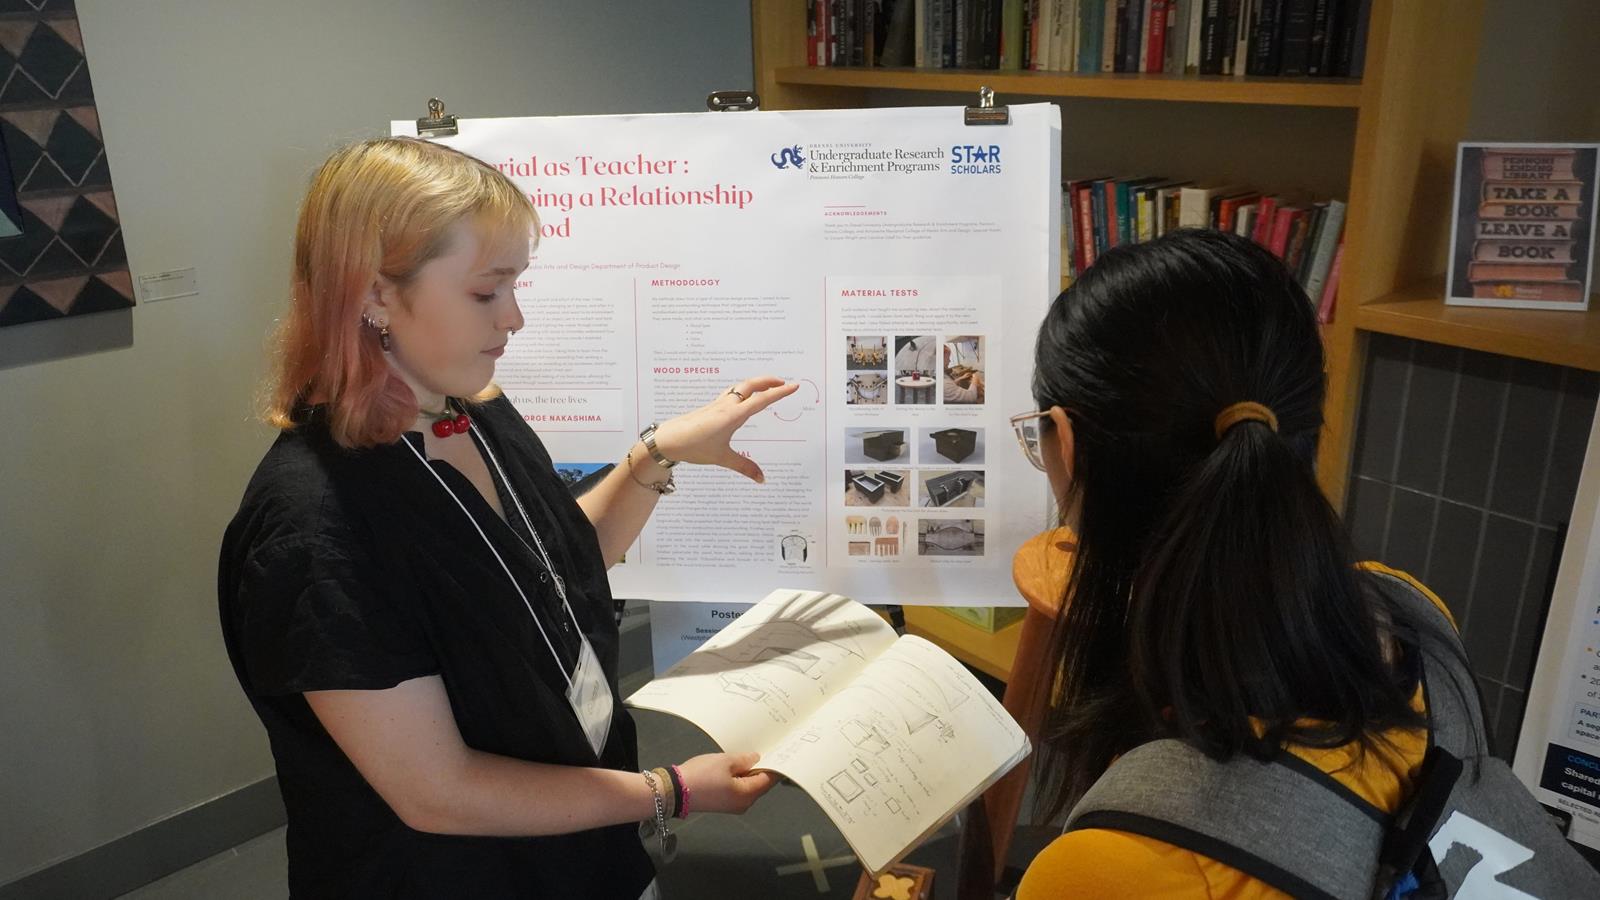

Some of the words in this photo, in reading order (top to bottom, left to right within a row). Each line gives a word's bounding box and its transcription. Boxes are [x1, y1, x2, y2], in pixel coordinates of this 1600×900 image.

[810, 148, 892, 162] Undergraduate
[895, 147, 945, 159] Research
[951, 145, 1001, 164] STAR
[493, 156, 537, 177] rial
[544, 162, 570, 177] as
[576, 154, 677, 177] Teacher
[810, 162, 819, 173] &
[821, 161, 884, 173] Enrichment
[887, 161, 941, 174] Programs
[951, 165, 1002, 175] SCHOLARS
[530, 188, 573, 212] ing
[579, 193, 593, 207] a
[600, 184, 754, 210] Relationship
[1493, 187, 1547, 200] TAKE
[1553, 187, 1570, 200] A
[1504, 205, 1559, 217] BOOK
[541, 217, 570, 238] od
[1480, 223, 1545, 237] LEAVE
[1552, 225, 1569, 237] A
[1497, 246, 1556, 259] BOOK
[569, 263, 590, 272] Design
[591, 263, 626, 272] Department
[660, 262, 681, 271] Design
[651, 279, 720, 287] METHODOLOGY
[890, 289, 919, 297] TESTS
[536, 395, 548, 404] the
[1580, 708, 1600, 720] PAR
[1561, 781, 1596, 799] capital
